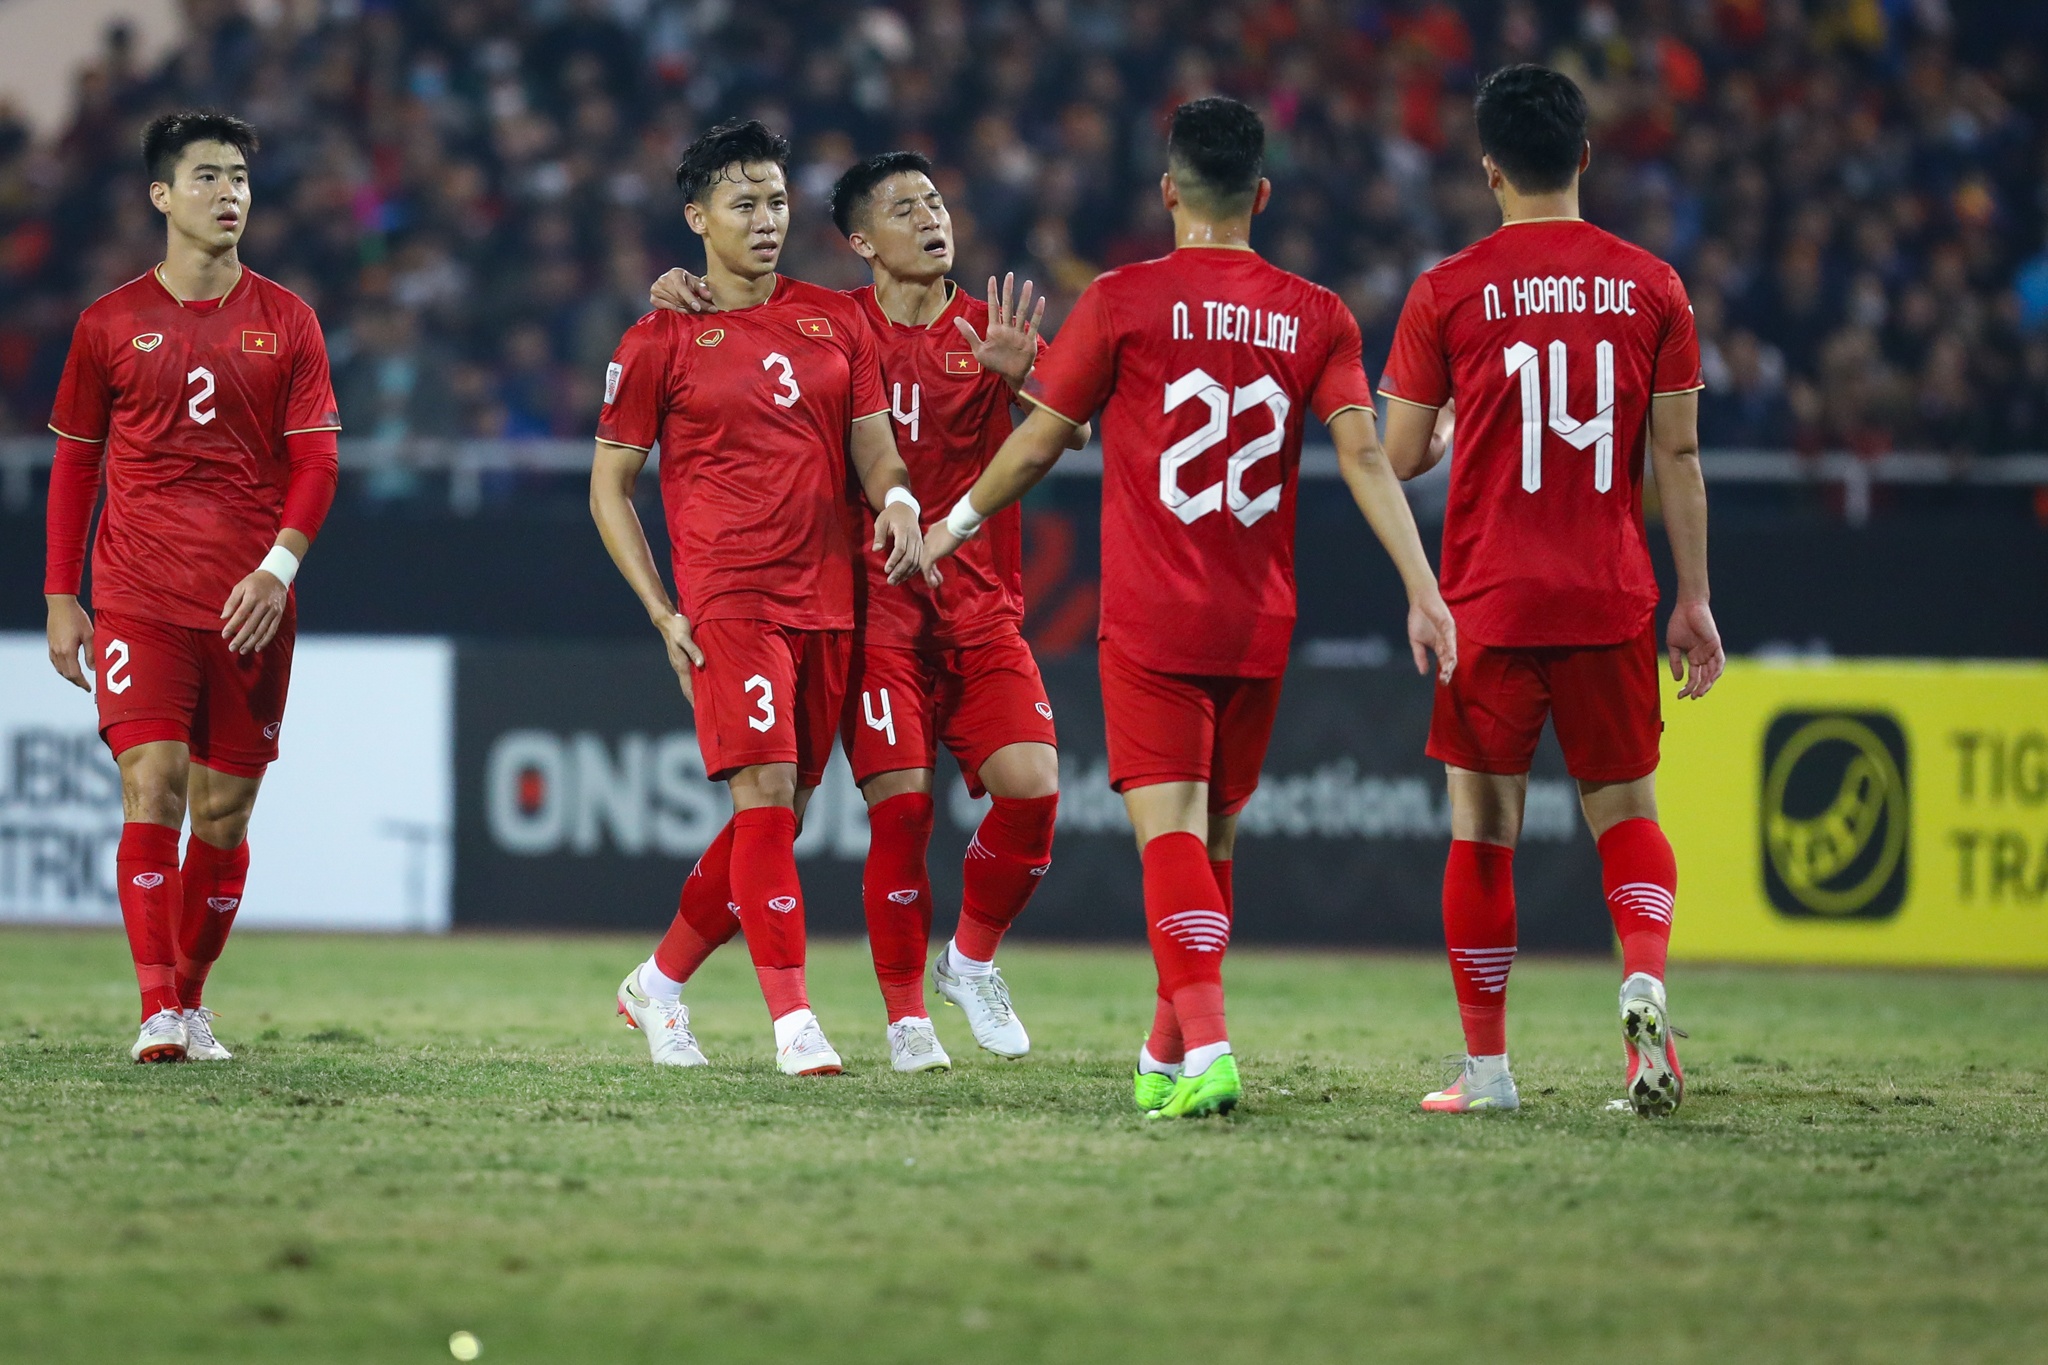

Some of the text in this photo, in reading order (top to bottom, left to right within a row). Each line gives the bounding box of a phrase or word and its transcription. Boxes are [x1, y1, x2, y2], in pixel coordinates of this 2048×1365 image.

[1172, 301, 1299, 354] N. TIEN LINH
[1483, 275, 1637, 321] N. HOANG DUC
[187, 366, 217, 426] 2
[763, 352, 801, 408] 3
[892, 382, 921, 442] 4
[1504, 339, 1615, 495] 14
[1159, 367, 1291, 528] 22
[105, 638, 132, 695] 2
[744, 673, 777, 733] 3
[862, 687, 896, 746] 4
